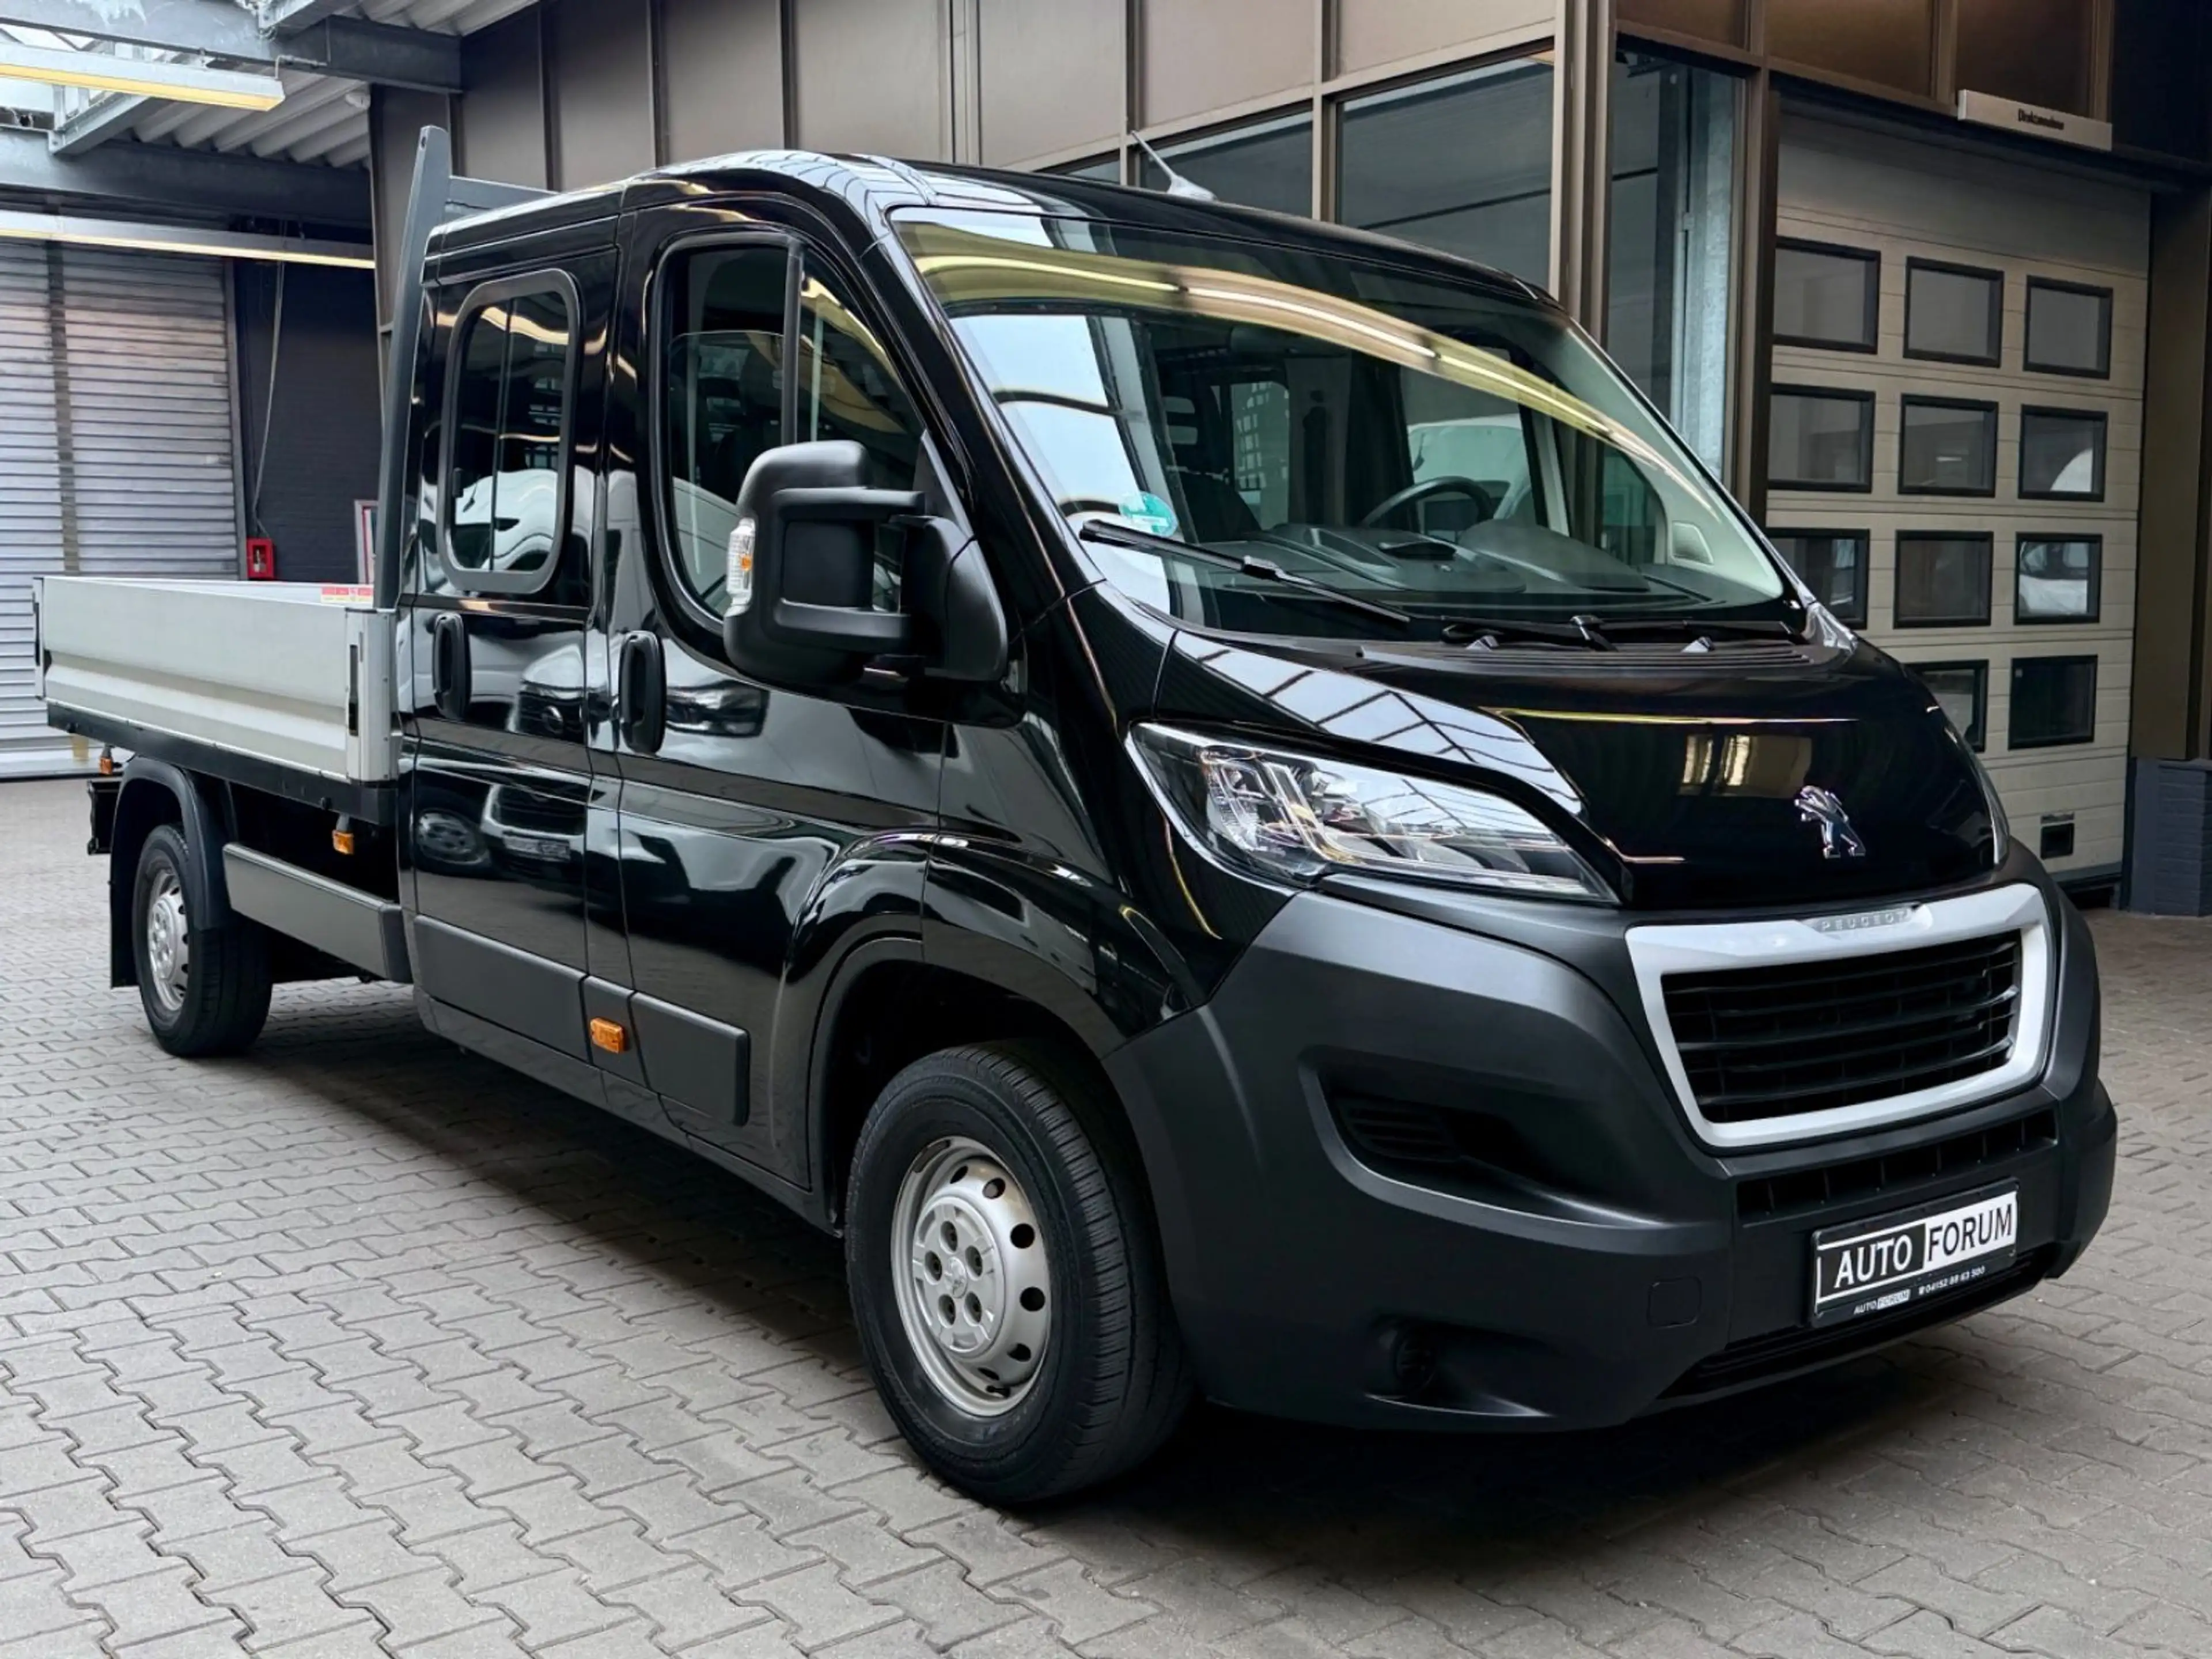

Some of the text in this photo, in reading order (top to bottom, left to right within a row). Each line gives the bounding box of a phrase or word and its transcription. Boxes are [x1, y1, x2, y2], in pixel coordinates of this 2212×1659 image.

[1821, 911, 1905, 931] PEUGEOT
[1834, 1203, 2012, 1289] AUTO FORUM
